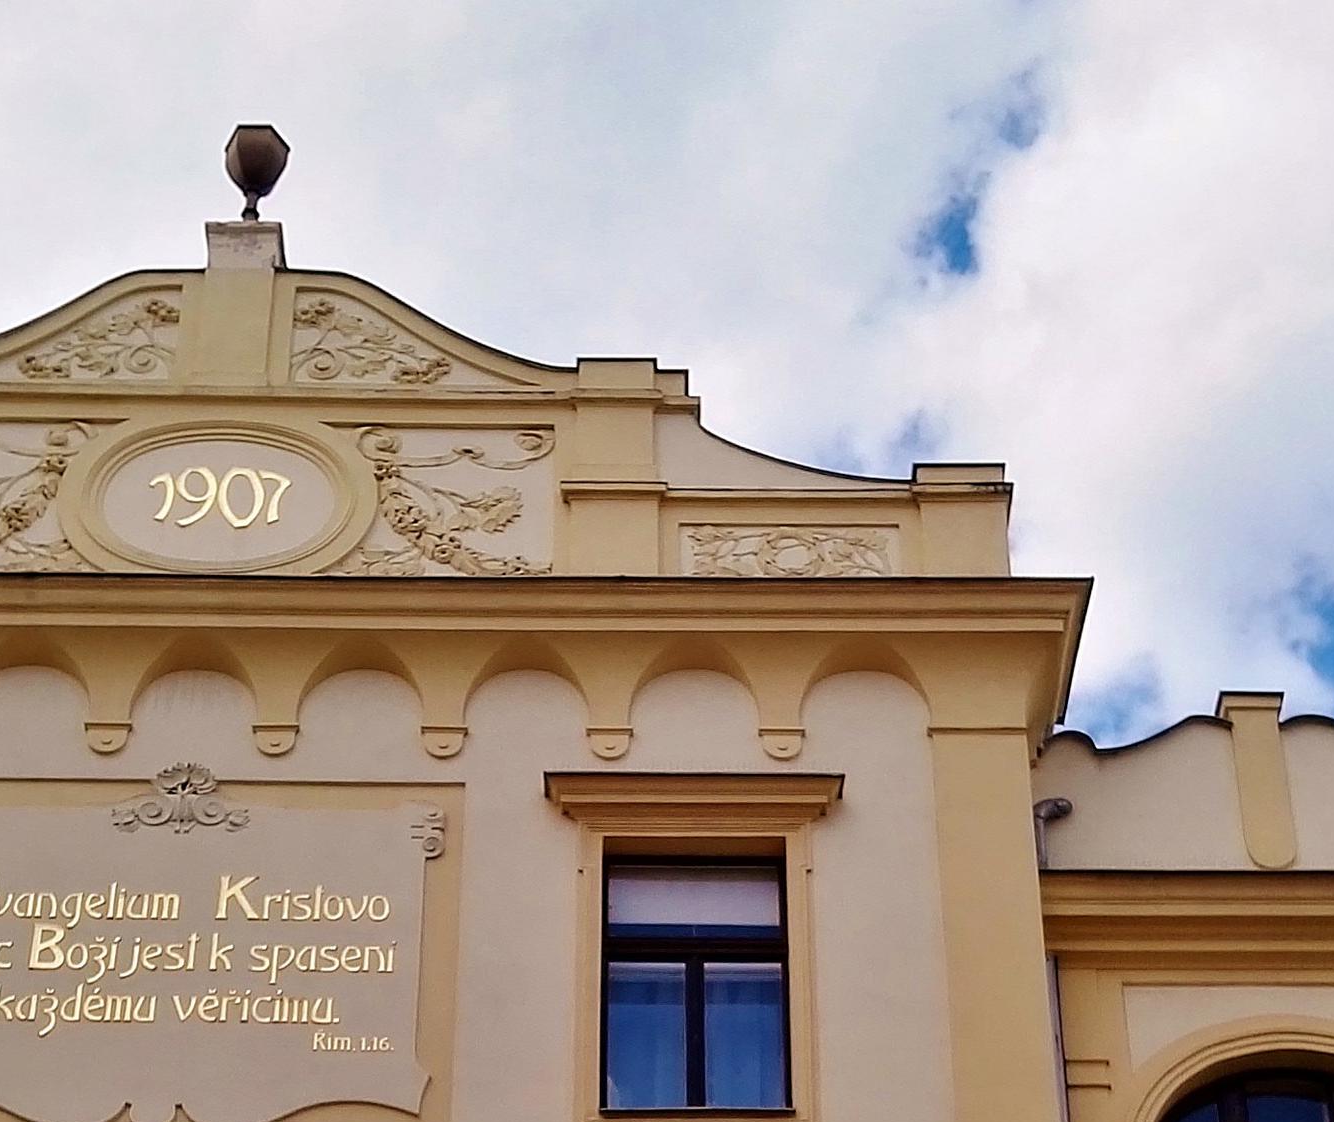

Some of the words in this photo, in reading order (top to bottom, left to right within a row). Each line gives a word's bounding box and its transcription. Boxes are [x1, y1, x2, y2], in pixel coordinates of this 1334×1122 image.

[149, 466, 292, 528] 1907
[214, 874, 390, 921] Kristovo
[28, 922, 121, 984] Boží
[118, 932, 200, 978] jest
[208, 932, 235, 970] k
[360, 1036, 396, 1051] 1.16.
